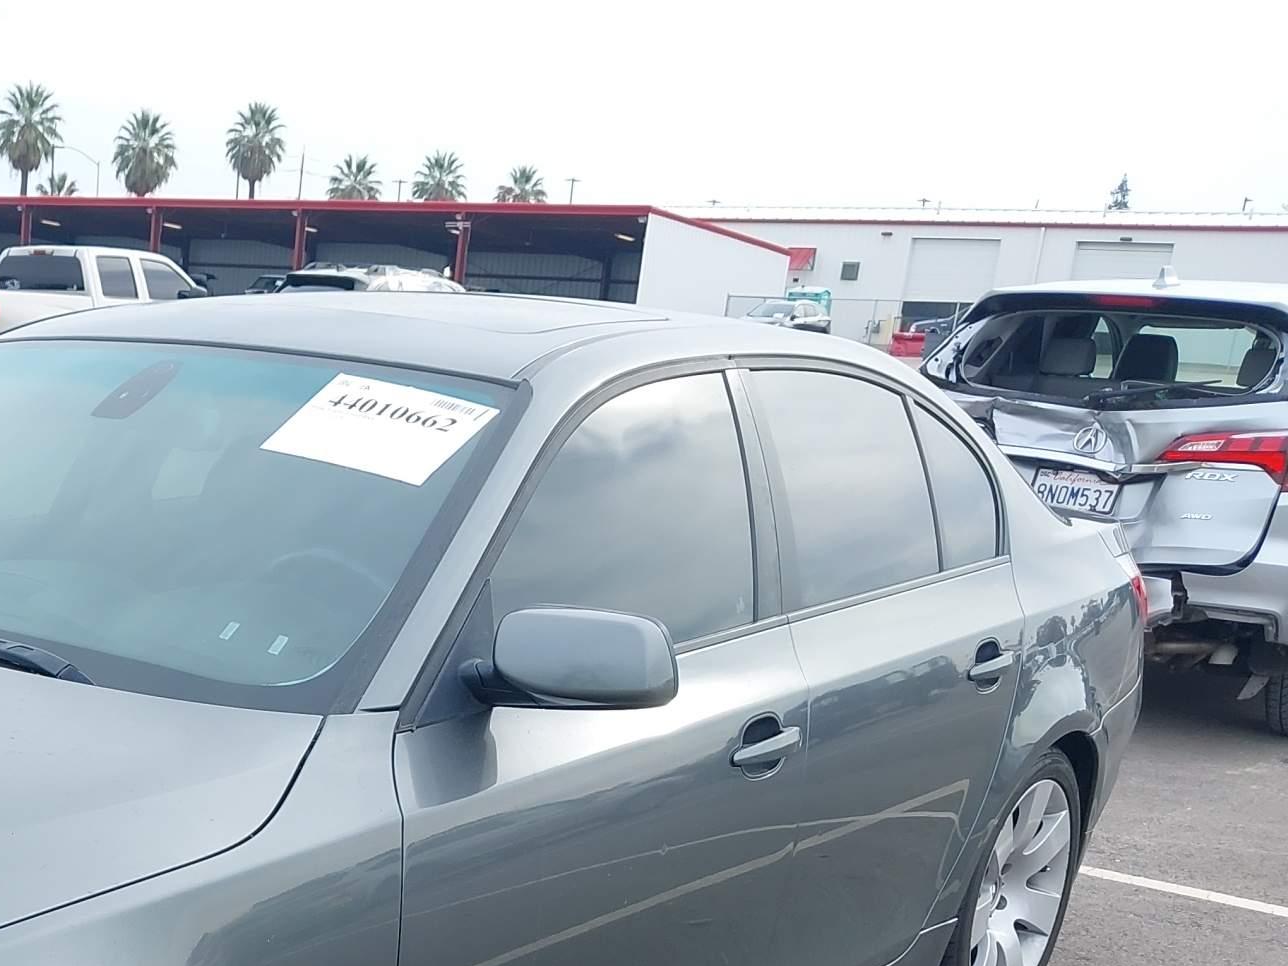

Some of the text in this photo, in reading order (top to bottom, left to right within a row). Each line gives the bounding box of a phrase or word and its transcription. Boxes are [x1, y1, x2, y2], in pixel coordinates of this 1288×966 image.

[328, 394, 457, 432] 44010662
[1184, 471, 1240, 482] RDX
[1180, 512, 1213, 521] AWD
